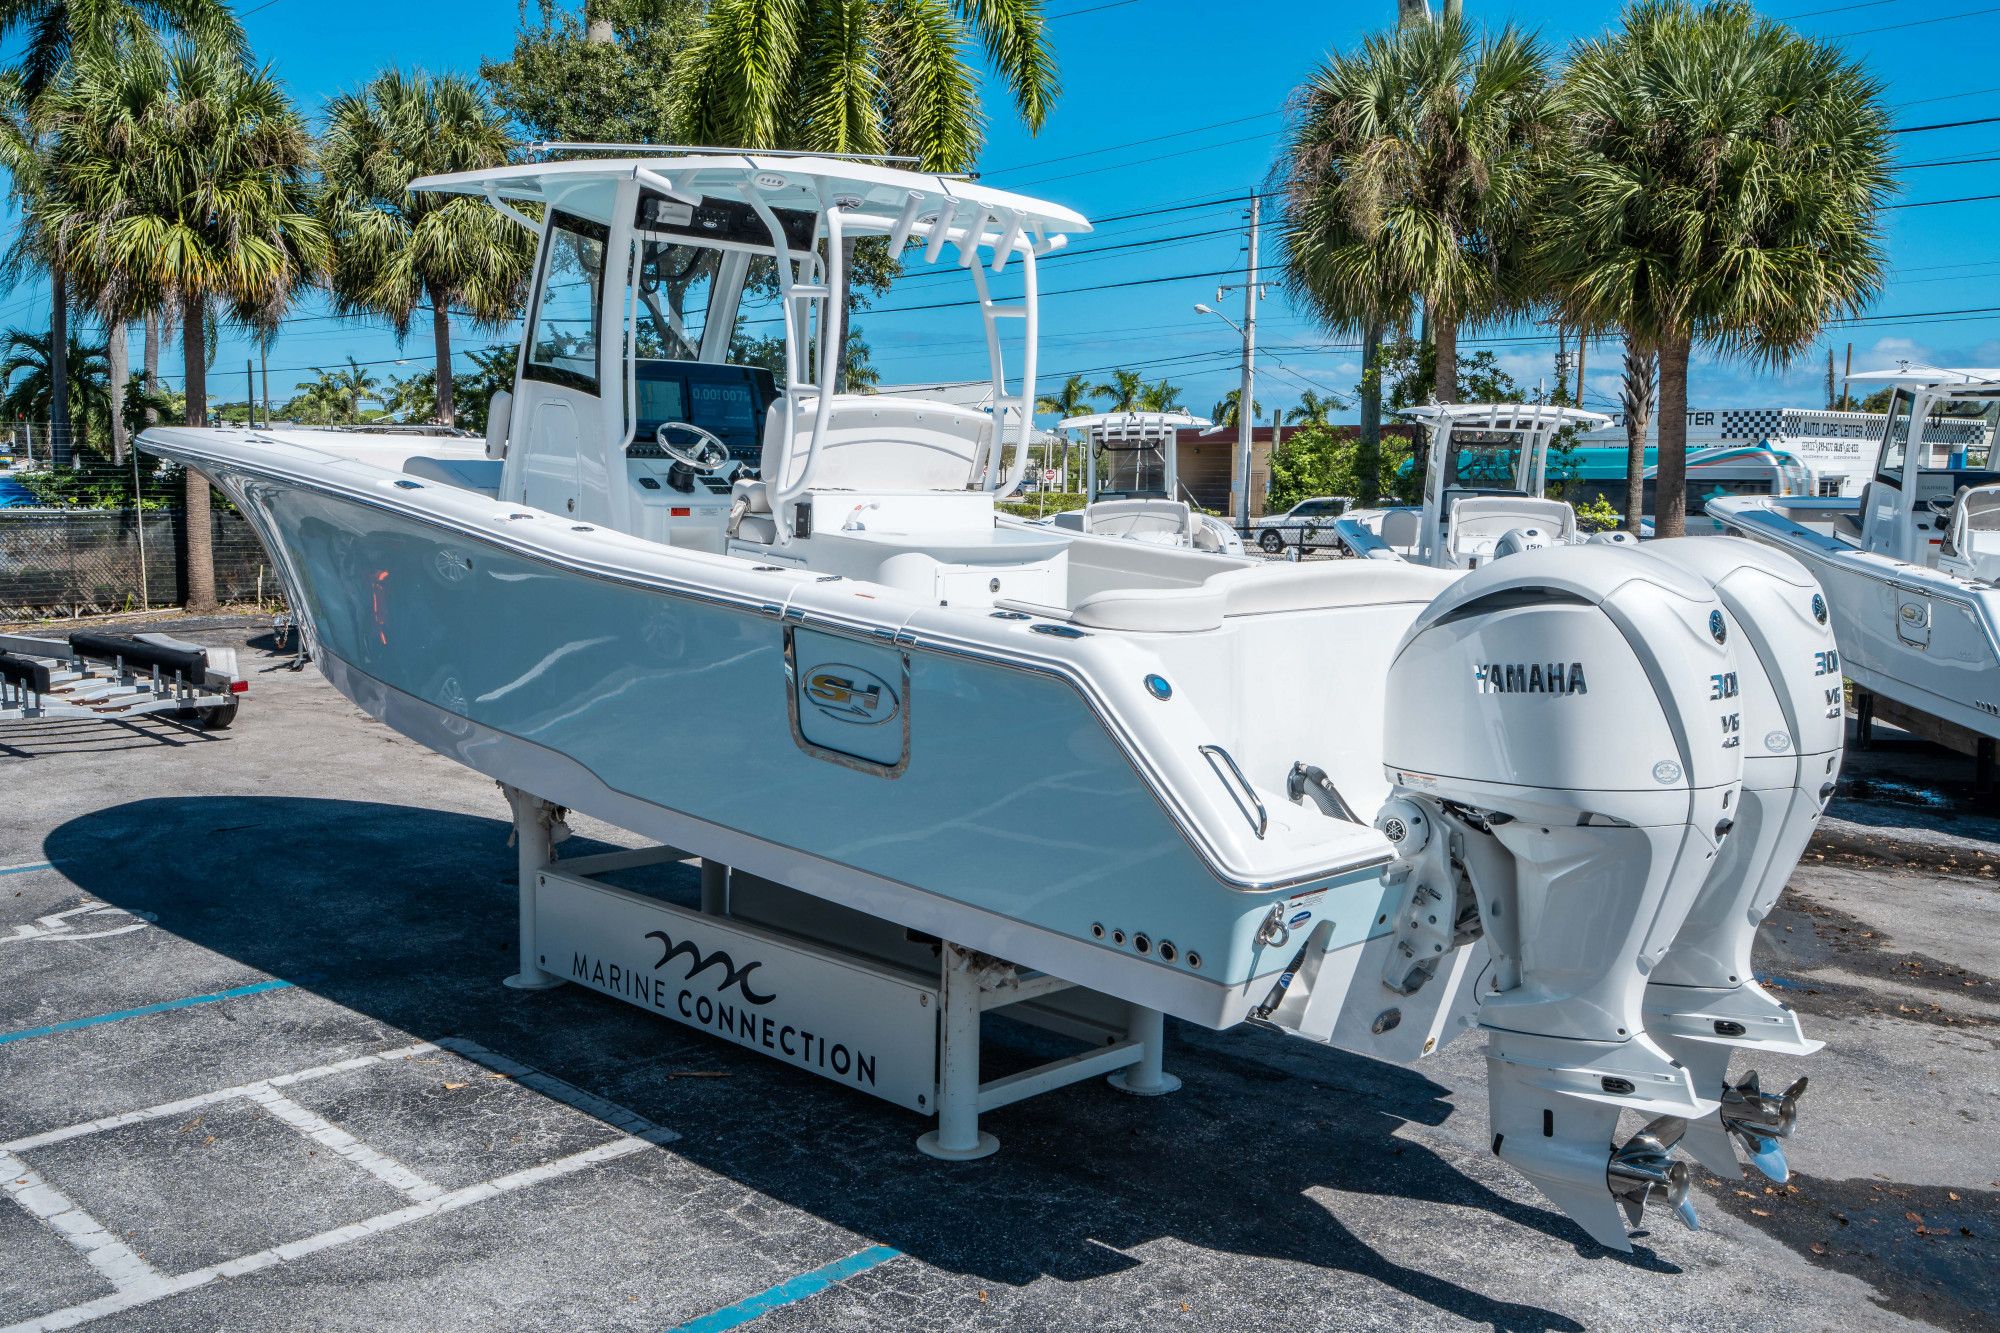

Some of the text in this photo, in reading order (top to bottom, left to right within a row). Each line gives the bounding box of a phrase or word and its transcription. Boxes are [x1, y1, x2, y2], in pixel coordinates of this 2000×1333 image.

[1686, 411, 1715, 426] TER
[1803, 422, 1820, 436] AUTO
[1822, 423, 1839, 437] CARE
[1473, 662, 1588, 696] YAMAHA
[1825, 687, 1841, 706] V6
[1720, 712, 1740, 734] V6
[572, 951, 876, 1088] MARINE CONNECTION
